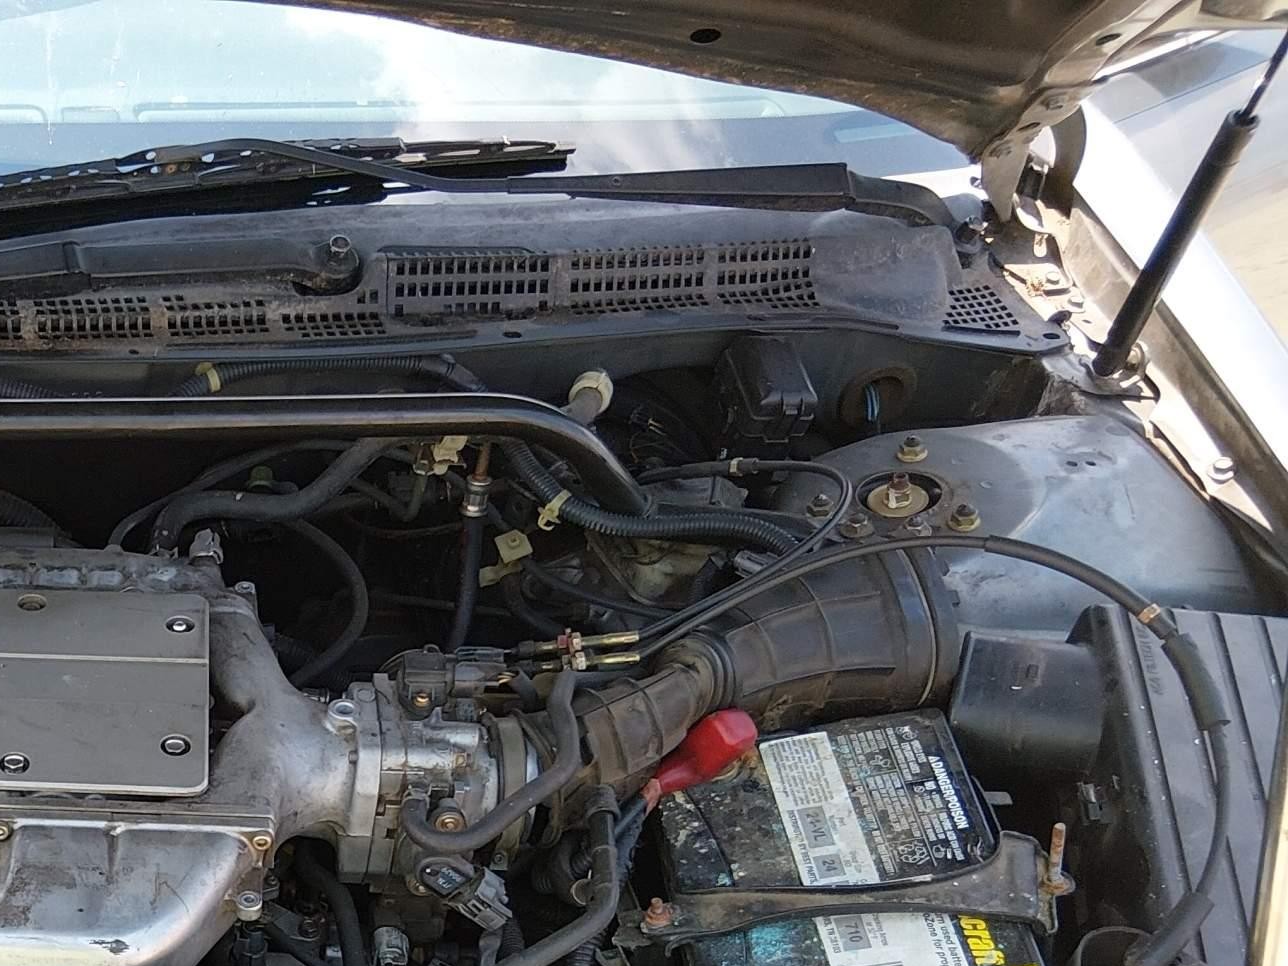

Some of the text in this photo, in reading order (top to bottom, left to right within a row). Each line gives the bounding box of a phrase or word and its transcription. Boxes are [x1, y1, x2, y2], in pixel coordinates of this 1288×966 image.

[821, 859, 838, 872] 24
[842, 922, 864, 943] 710
[921, 912, 939, 937] oZone
[931, 938, 945, 950] for
[940, 926, 955, 945] used
